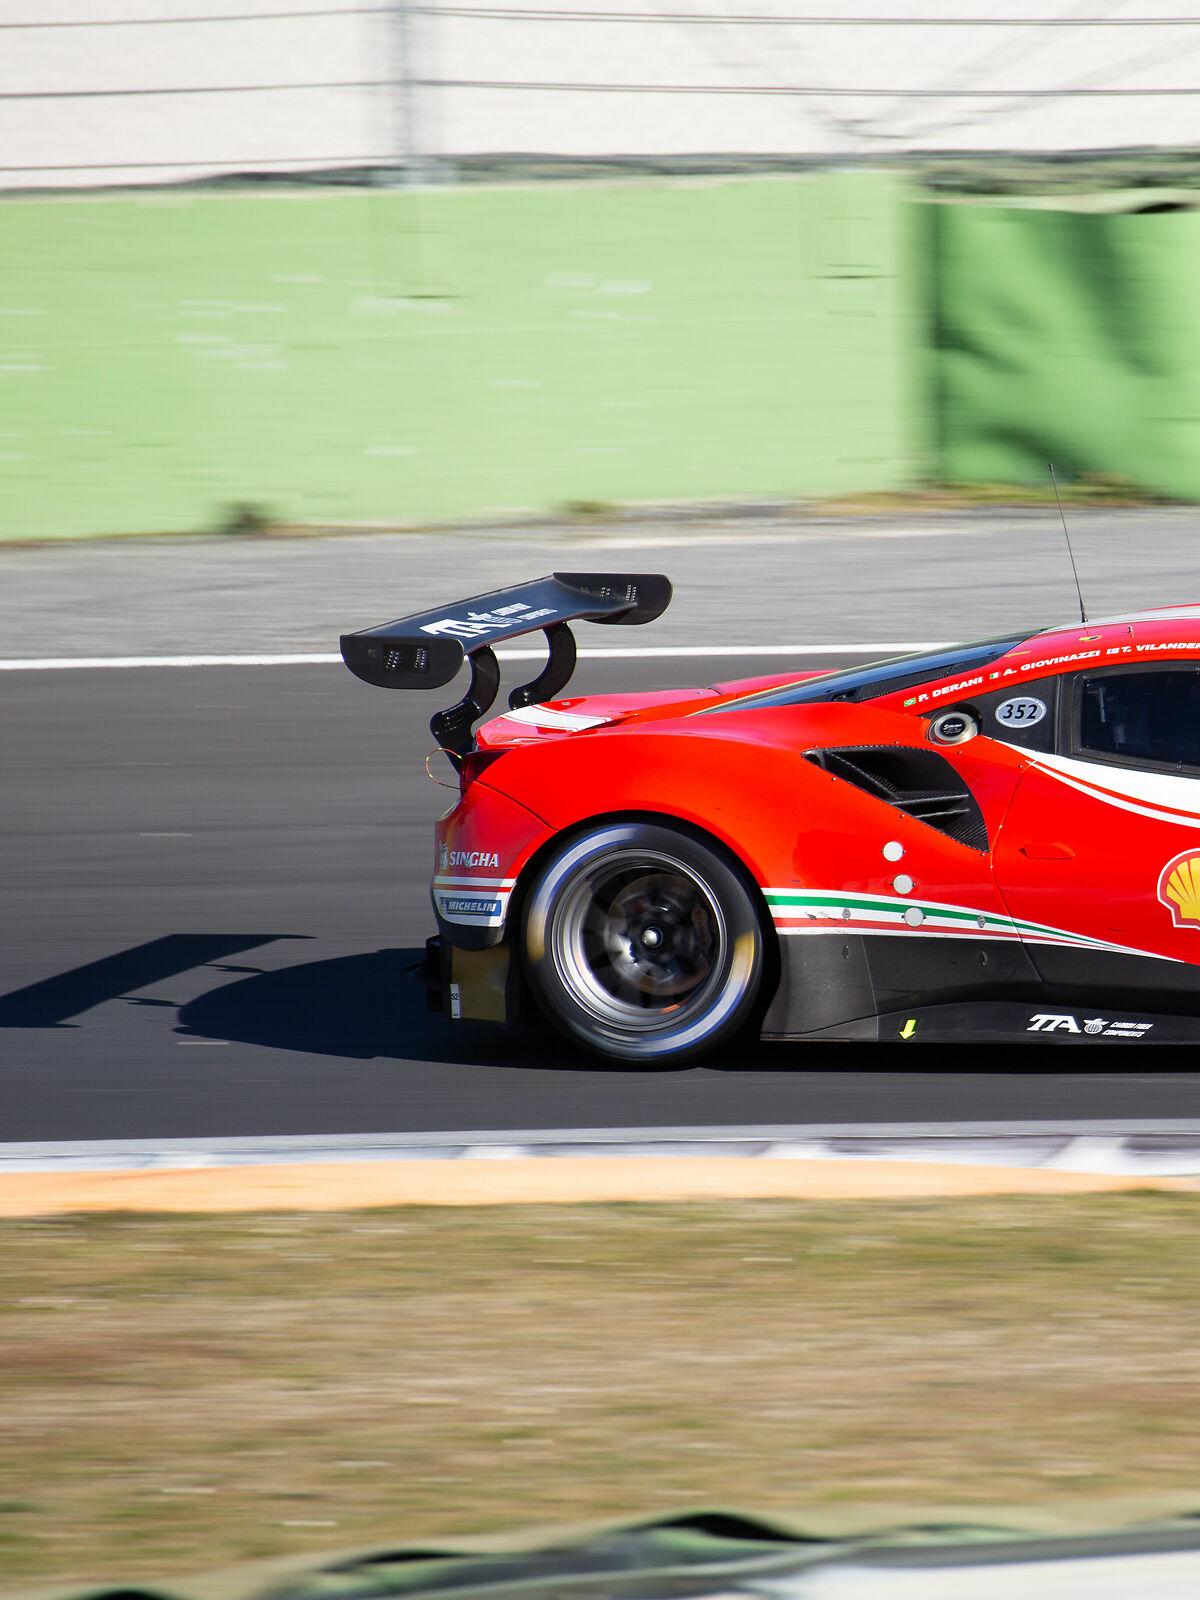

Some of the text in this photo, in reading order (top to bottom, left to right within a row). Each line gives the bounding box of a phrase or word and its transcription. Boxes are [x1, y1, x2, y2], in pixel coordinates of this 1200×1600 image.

[1002, 649, 1101, 677] A. GIOVINAZZI
[918, 676, 984, 703] P. DERANI
[1002, 703, 1039, 720] 352
[449, 850, 500, 868] SINGHA
[448, 901, 498, 912] MICHELIN
